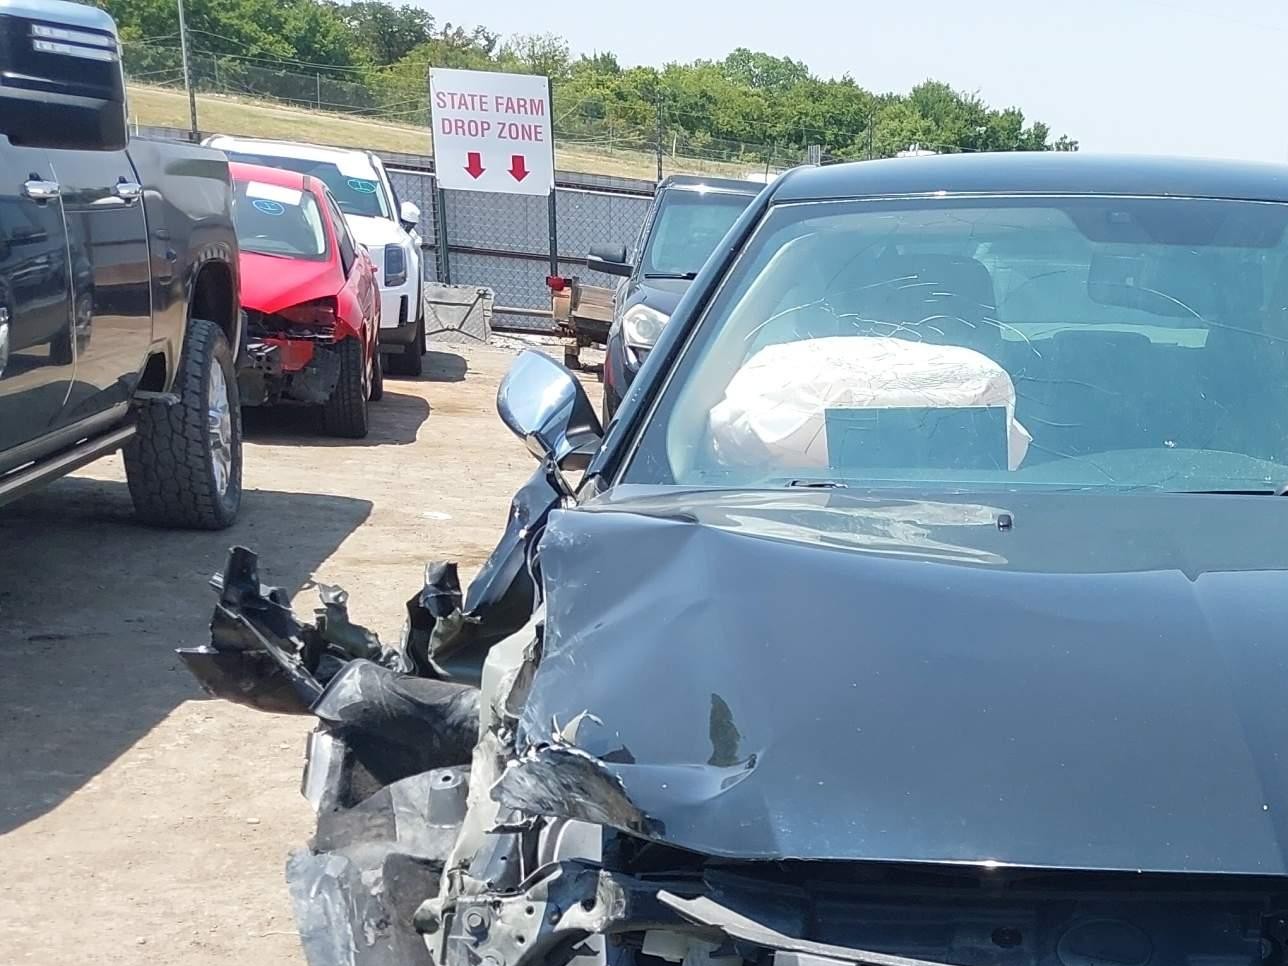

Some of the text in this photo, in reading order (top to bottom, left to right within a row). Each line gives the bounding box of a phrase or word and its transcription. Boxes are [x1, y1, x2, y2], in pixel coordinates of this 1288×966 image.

[436, 91, 545, 116] STATE FARM
[441, 118, 544, 142] DROP ZONE
